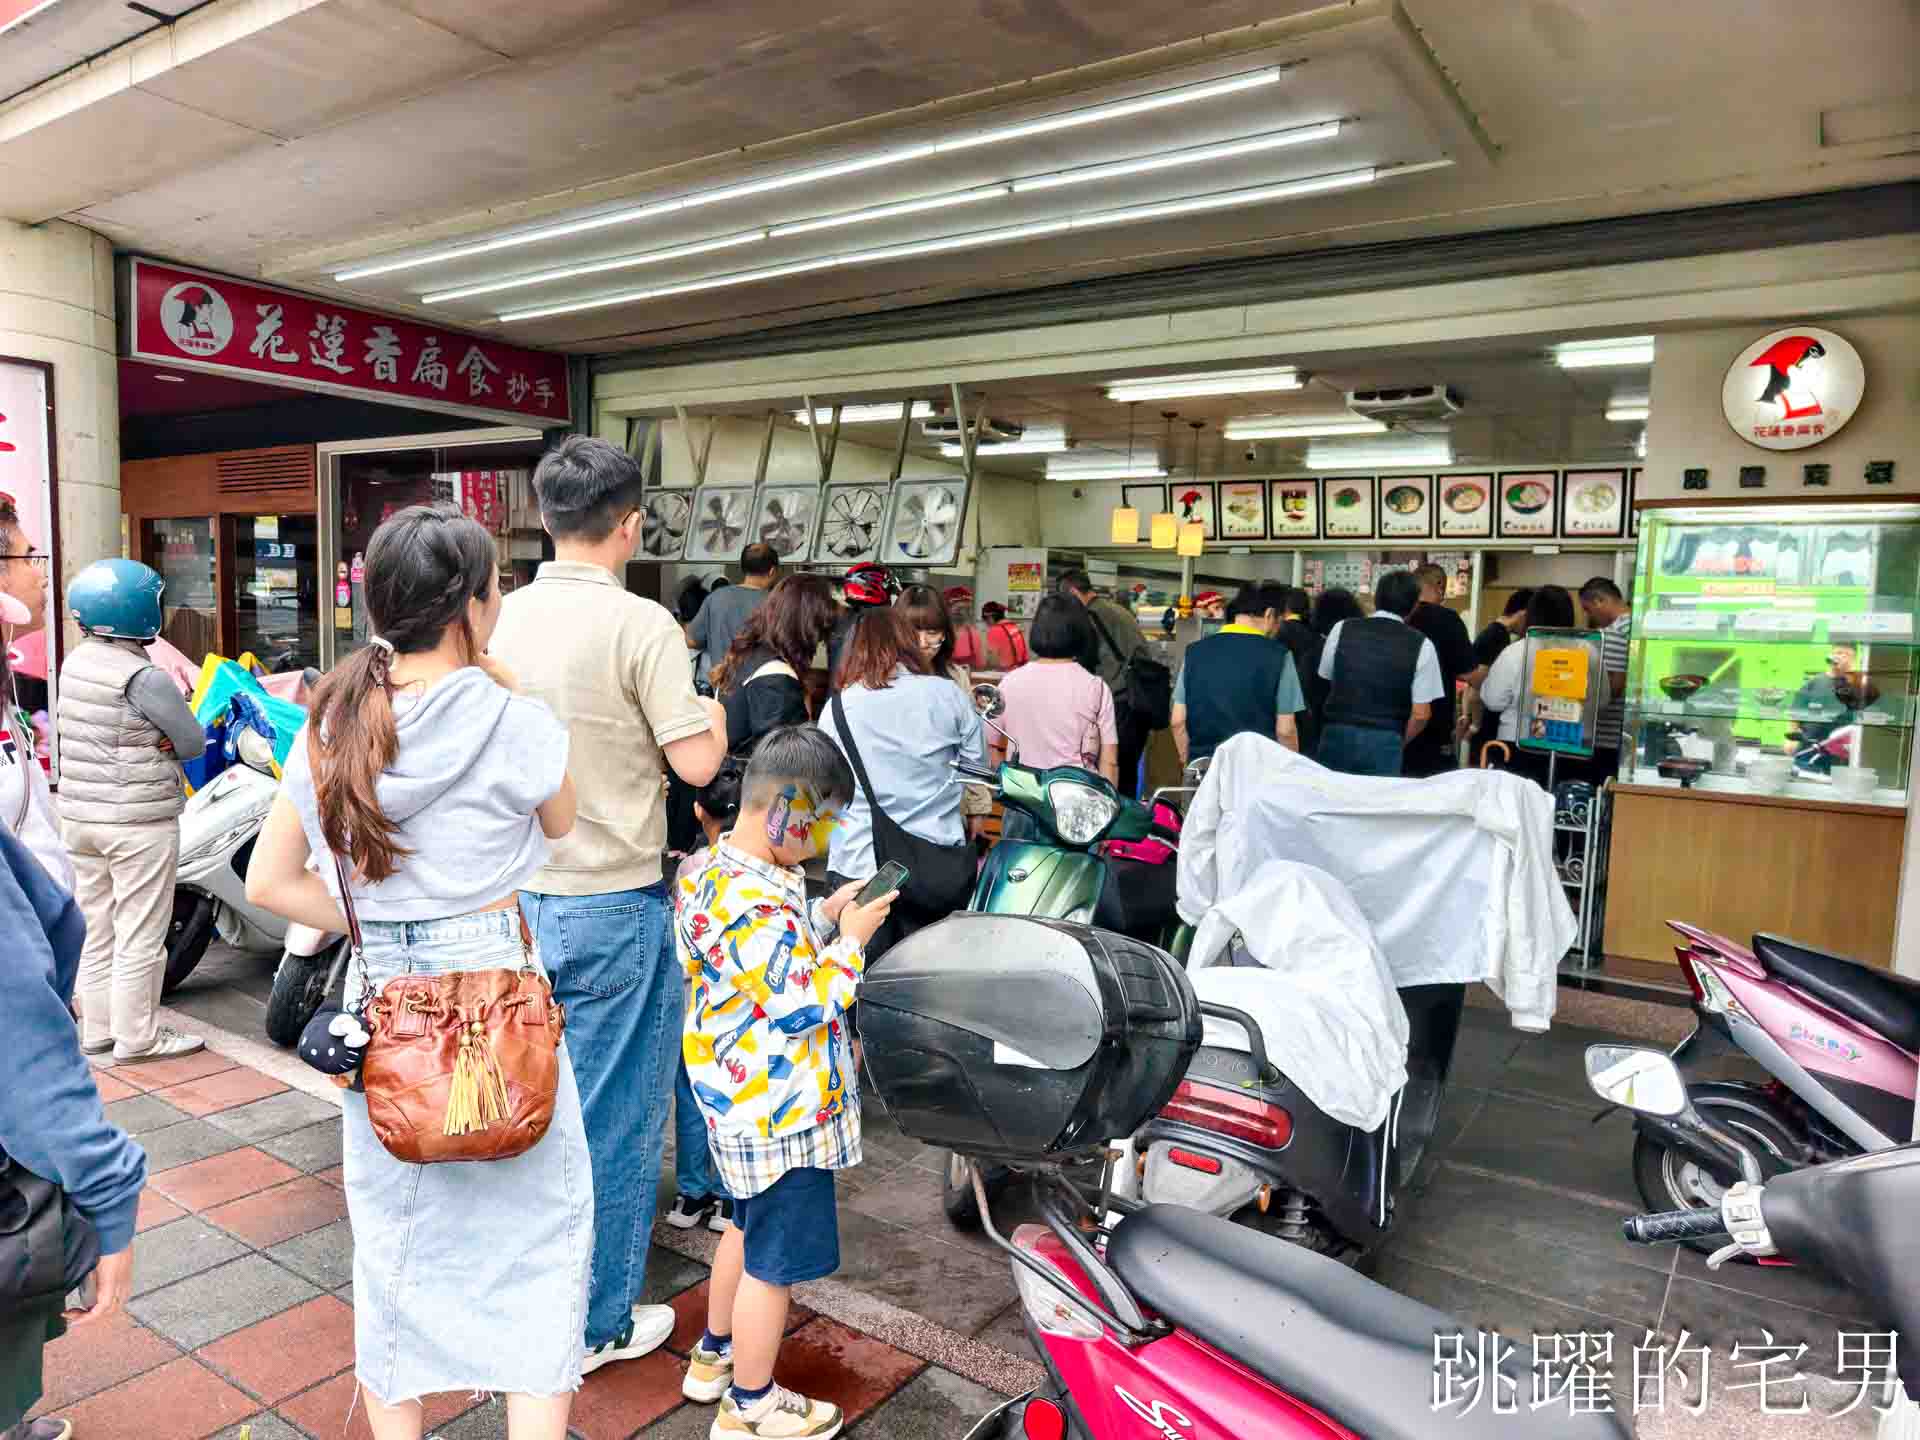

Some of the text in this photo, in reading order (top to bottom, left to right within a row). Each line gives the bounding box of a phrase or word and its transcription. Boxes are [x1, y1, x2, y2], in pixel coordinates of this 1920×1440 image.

[250, 304, 555, 408] 花蓮香扁食 抄手
